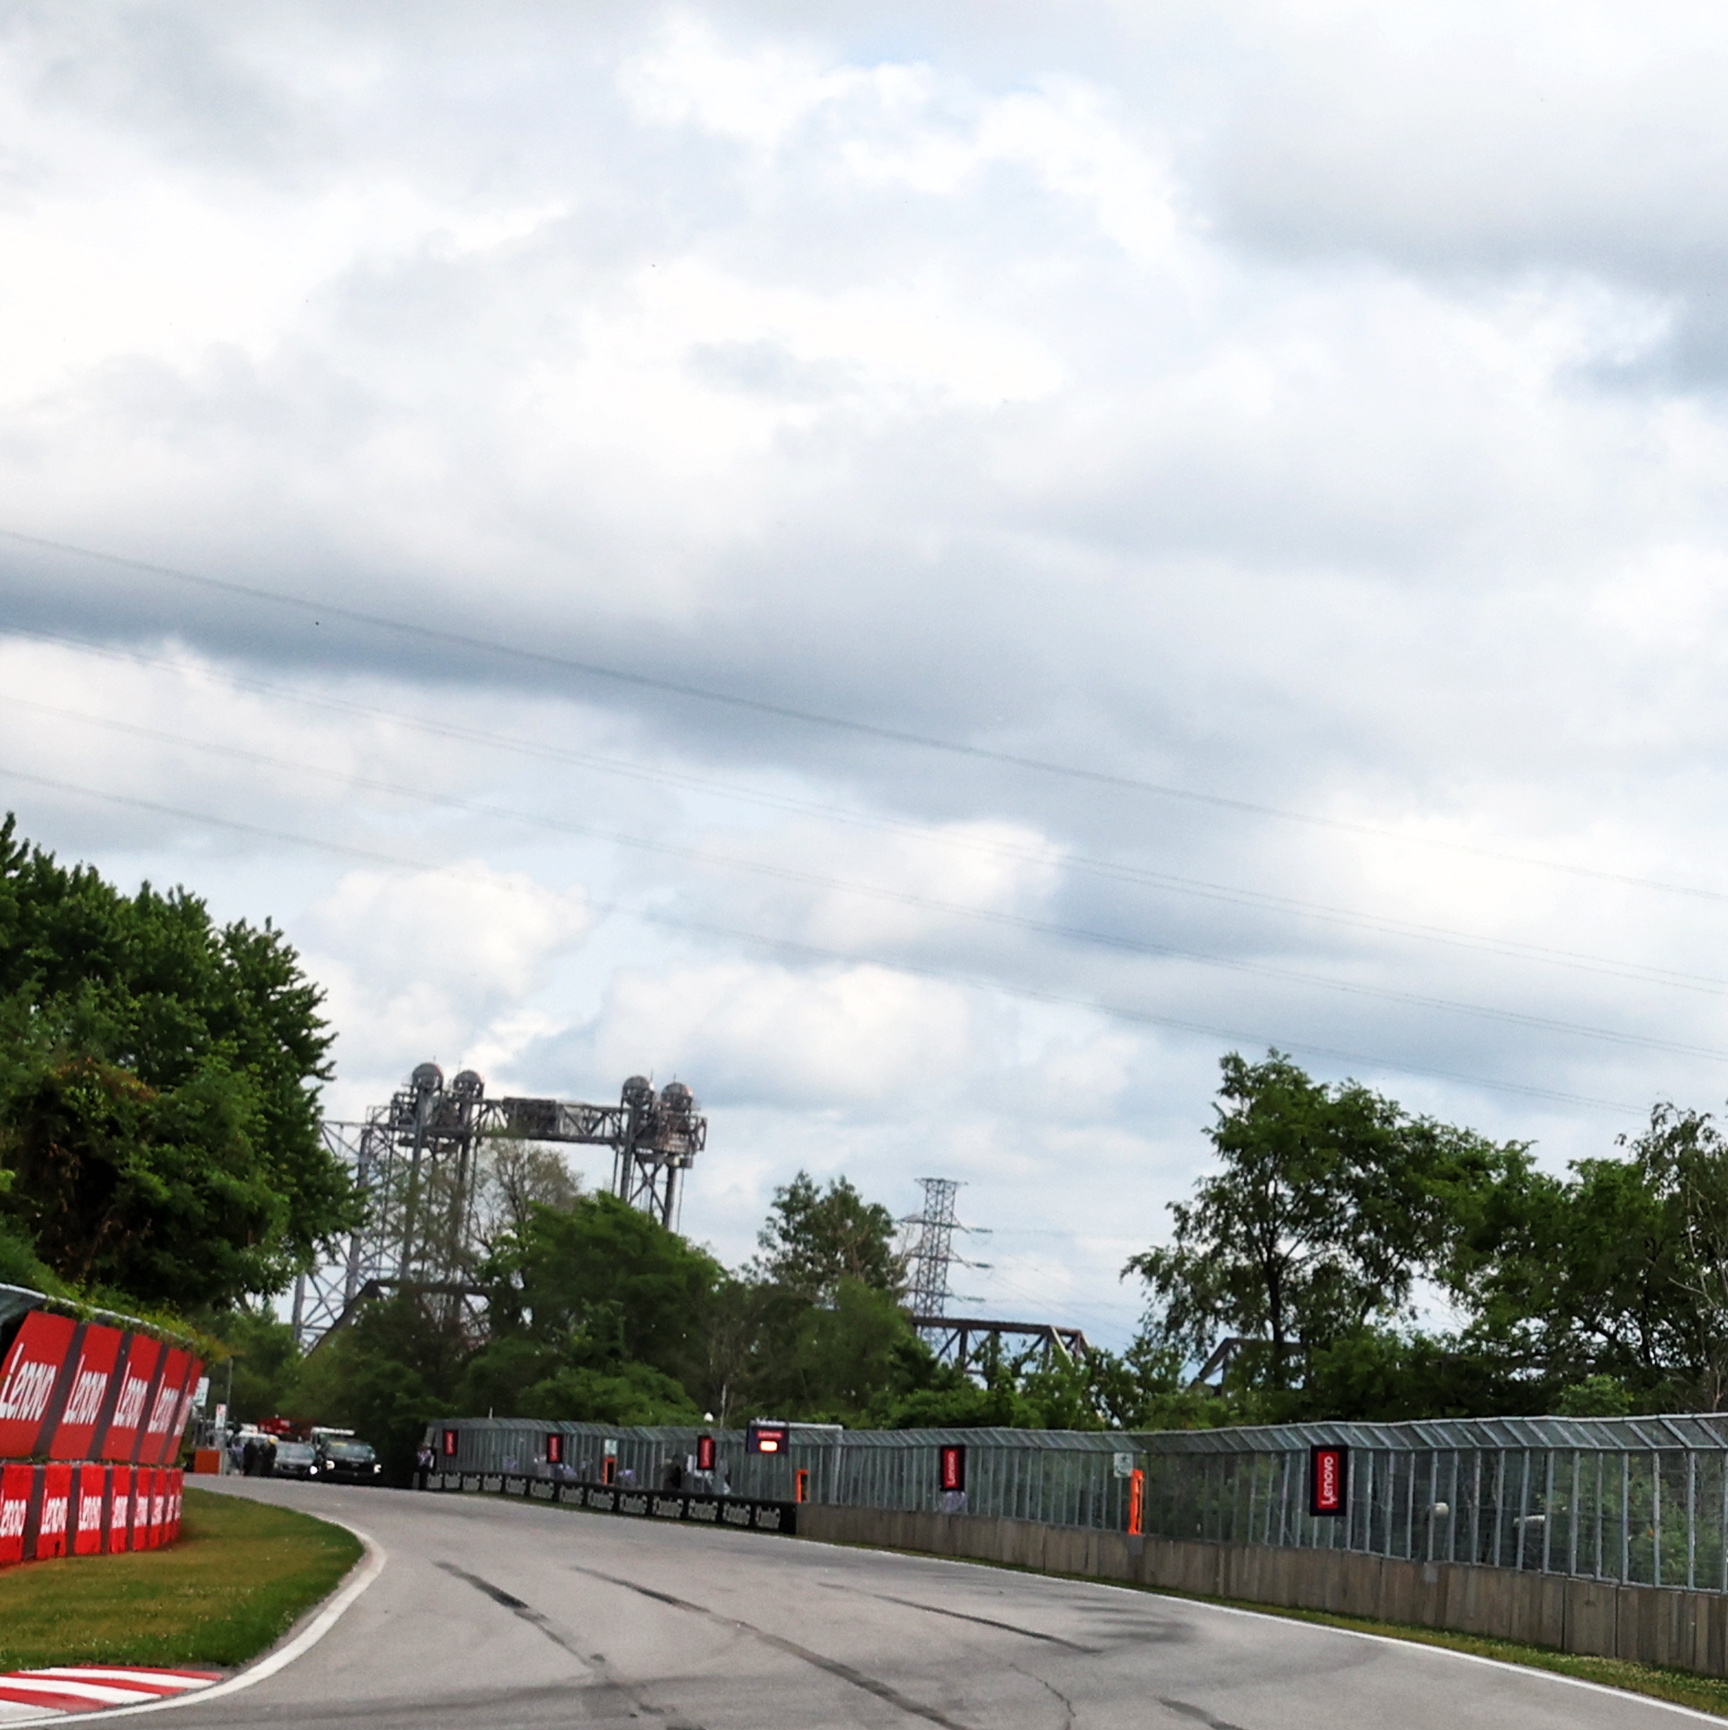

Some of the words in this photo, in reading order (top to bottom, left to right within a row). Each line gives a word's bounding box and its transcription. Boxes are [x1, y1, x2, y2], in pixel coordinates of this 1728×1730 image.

[0, 1343, 57, 1421] Lenovo
[62, 1354, 107, 1425] Lenovo
[1322, 1456, 1336, 1505] Lenovo
